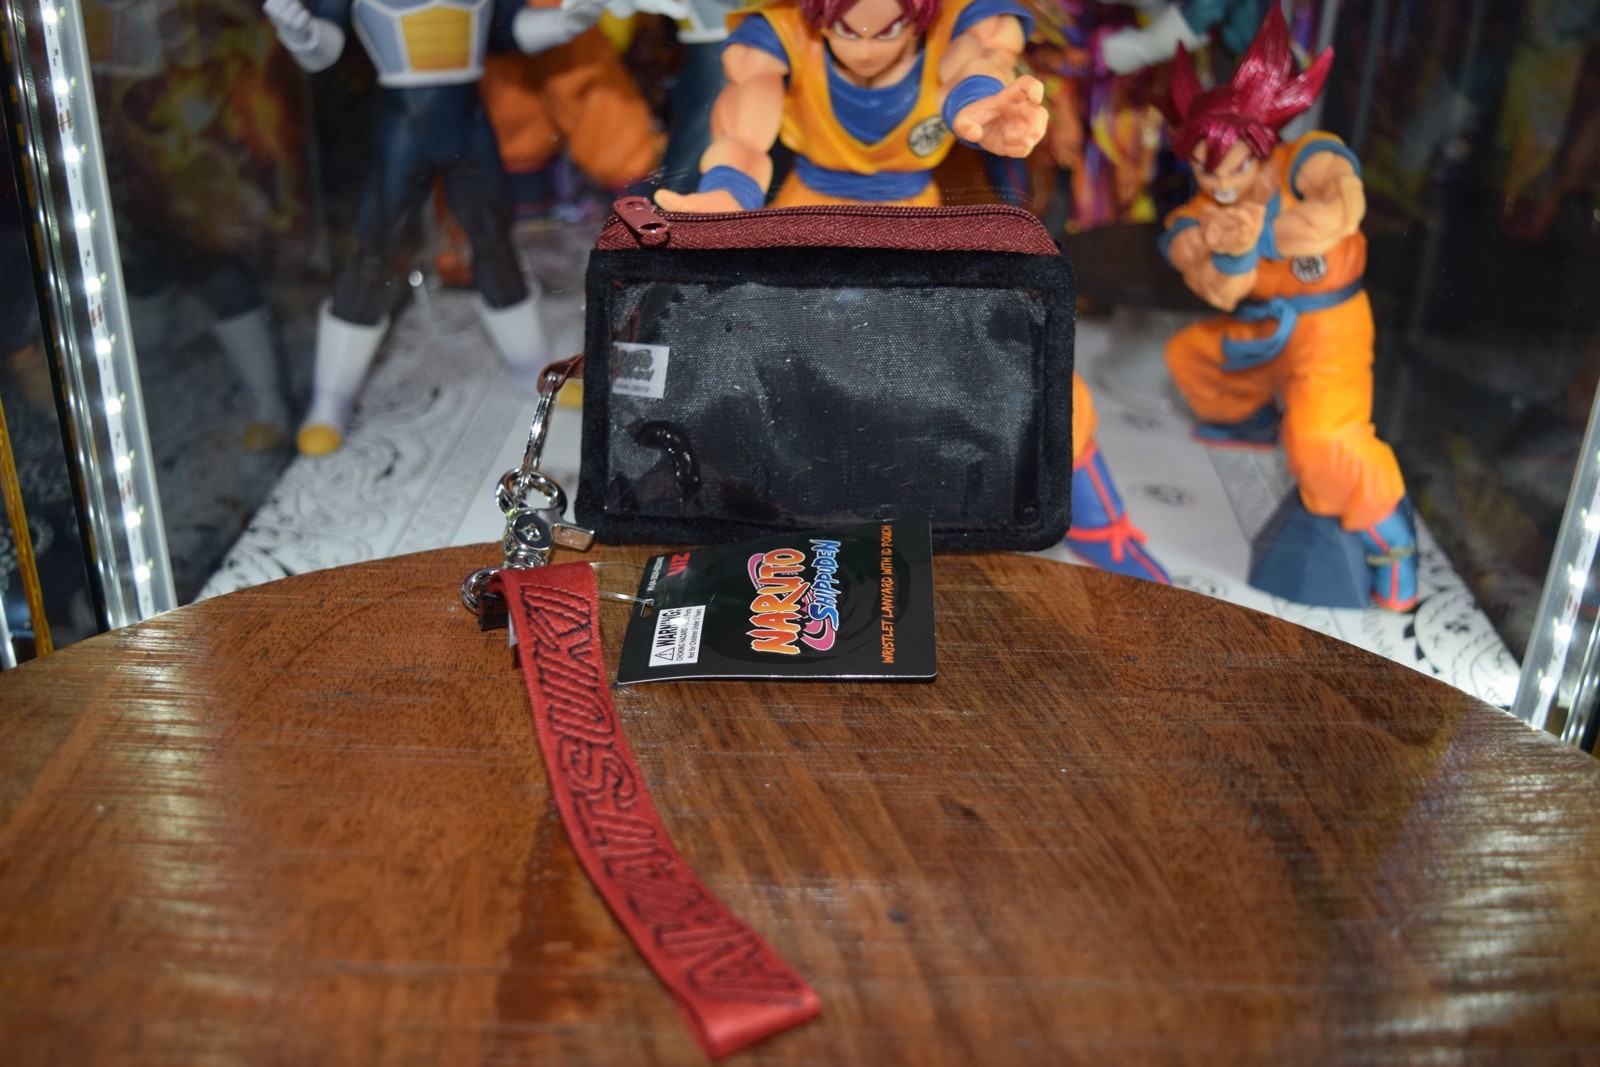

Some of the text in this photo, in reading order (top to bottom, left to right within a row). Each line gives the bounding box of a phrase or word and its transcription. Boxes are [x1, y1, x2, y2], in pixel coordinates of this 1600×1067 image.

[666, 552, 691, 577] VIZ
[746, 548, 810, 654] NARUTO
[808, 539, 842, 630] SHIPPUDEN
[880, 525, 894, 663] WRISTLET LANYARD WITH ID POUCH
[520, 584, 800, 1008] AKATSUKI
